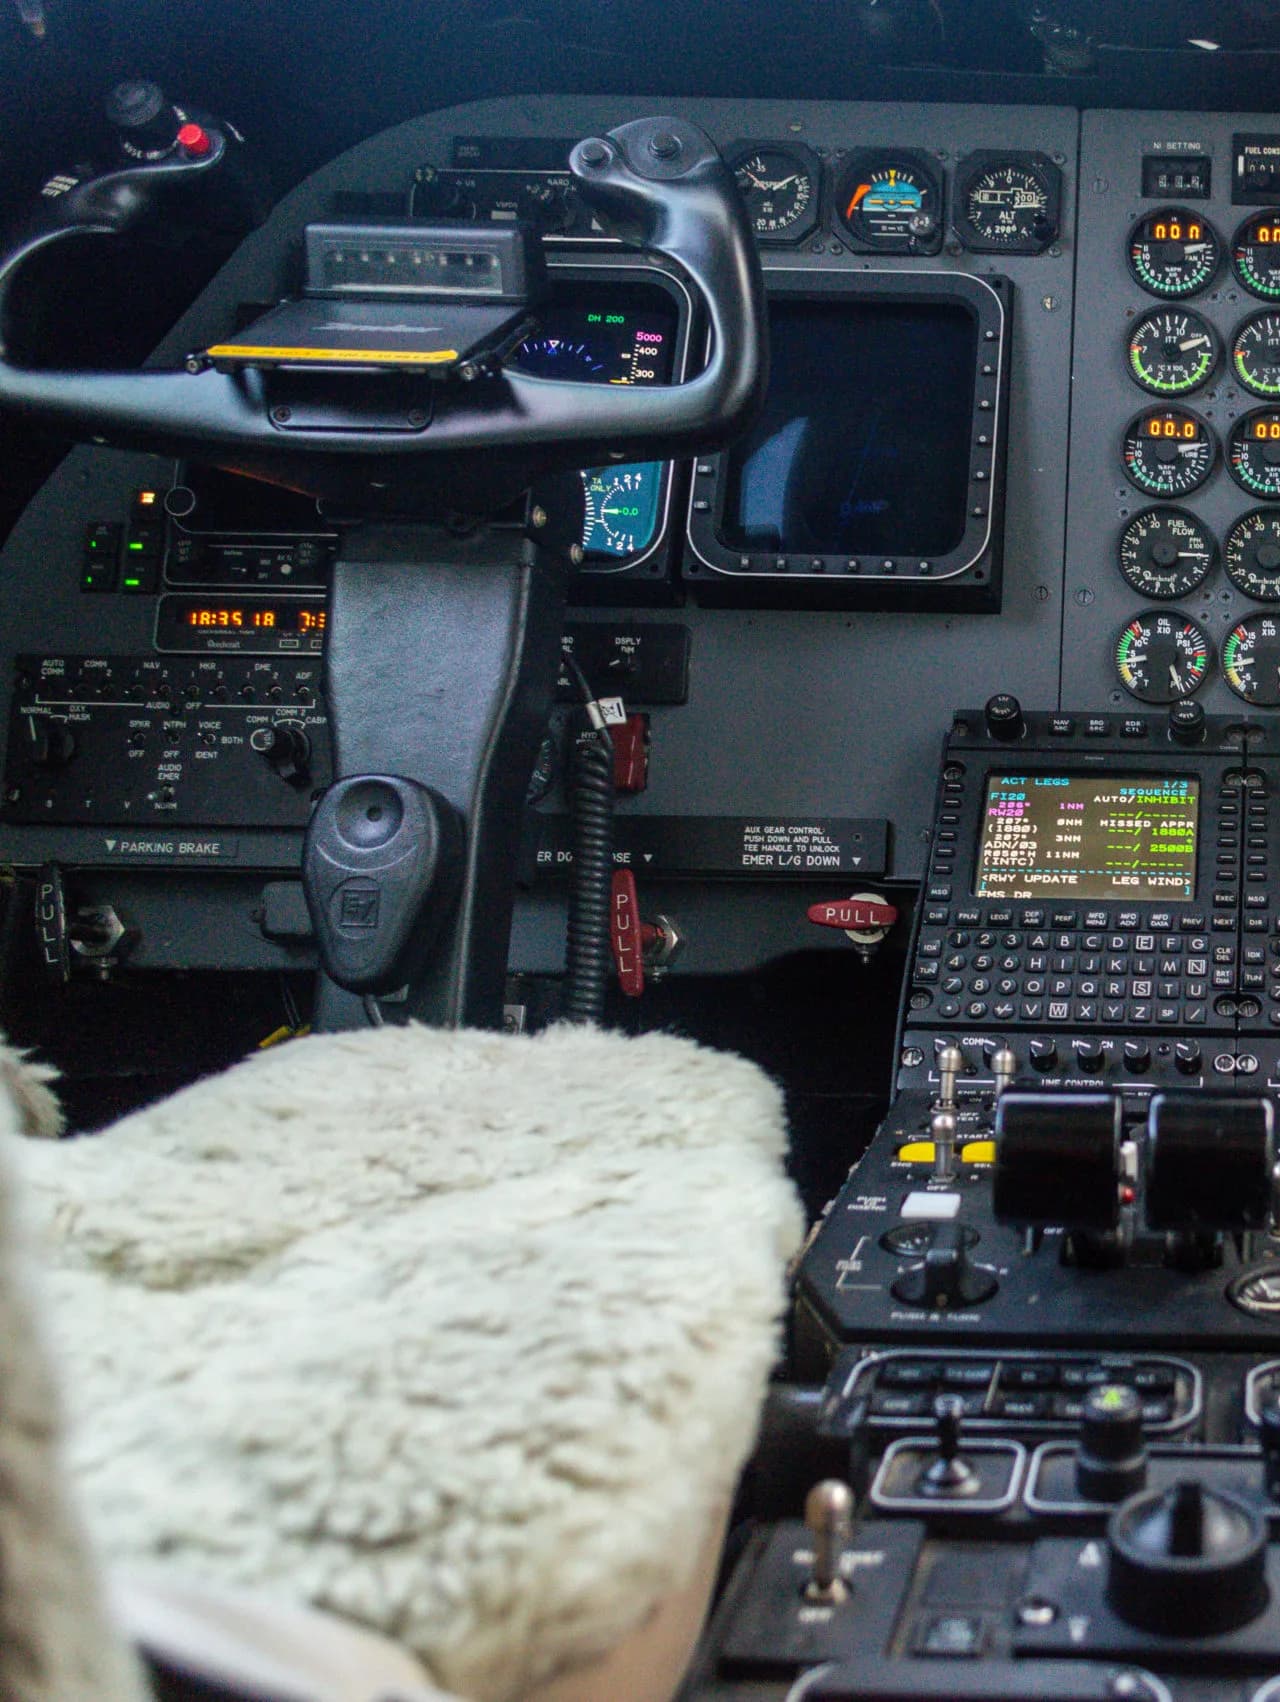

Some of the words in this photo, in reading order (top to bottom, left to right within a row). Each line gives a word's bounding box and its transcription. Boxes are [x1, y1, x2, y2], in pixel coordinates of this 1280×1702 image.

[1245, 147, 1262, 155] FUEL
[999, 211, 1015, 219] ALT
[606, 315, 624, 323] 200
[636, 332, 662, 342] 5000
[639, 348, 657, 356] 400
[635, 370, 654, 378] 300
[1150, 421, 1194, 437] 00.0
[1168, 520, 1186, 528] FUEL
[1172, 527, 1194, 536] FLOW
[1158, 618, 1170, 627] OIL
[1157, 626, 1171, 634] X10
[1262, 628, 1275, 636] X10
[146, 702, 170, 710] AUDIO
[199, 721, 221, 729] VOICE
[222, 736, 243, 744] BOTH
[1001, 777, 1027, 785] ACT
[1035, 778, 1070, 786] LEGS
[990, 792, 1026, 800] FI20
[1120, 788, 1187, 796] SEQUENCE
[1094, 795, 1196, 804] AUTO/INHIBIT
[988, 808, 1024, 816] RW20
[988, 825, 1038, 833] (1880)
[1151, 828, 1194, 836] 1880A
[1056, 834, 1081, 842] 3NM
[121, 842, 174, 854] PARKING
[179, 842, 220, 854] BRAKE
[984, 841, 1037, 849] ADN/03
[1149, 845, 1193, 853] 2500B
[743, 855, 773, 865] EMER
[779, 855, 801, 865] L/G
[807, 856, 840, 866] DOWN
[984, 857, 1034, 866] (INTC)
[981, 874, 1016, 883] <RWY
[1024, 875, 1078, 884] UPDATE
[1112, 876, 1140, 885] LEG
[1148, 877, 1191, 886] WIND>
[978, 890, 1005, 898] FMS
[826, 908, 880, 924] PULL
[616, 894, 633, 972] PULL
